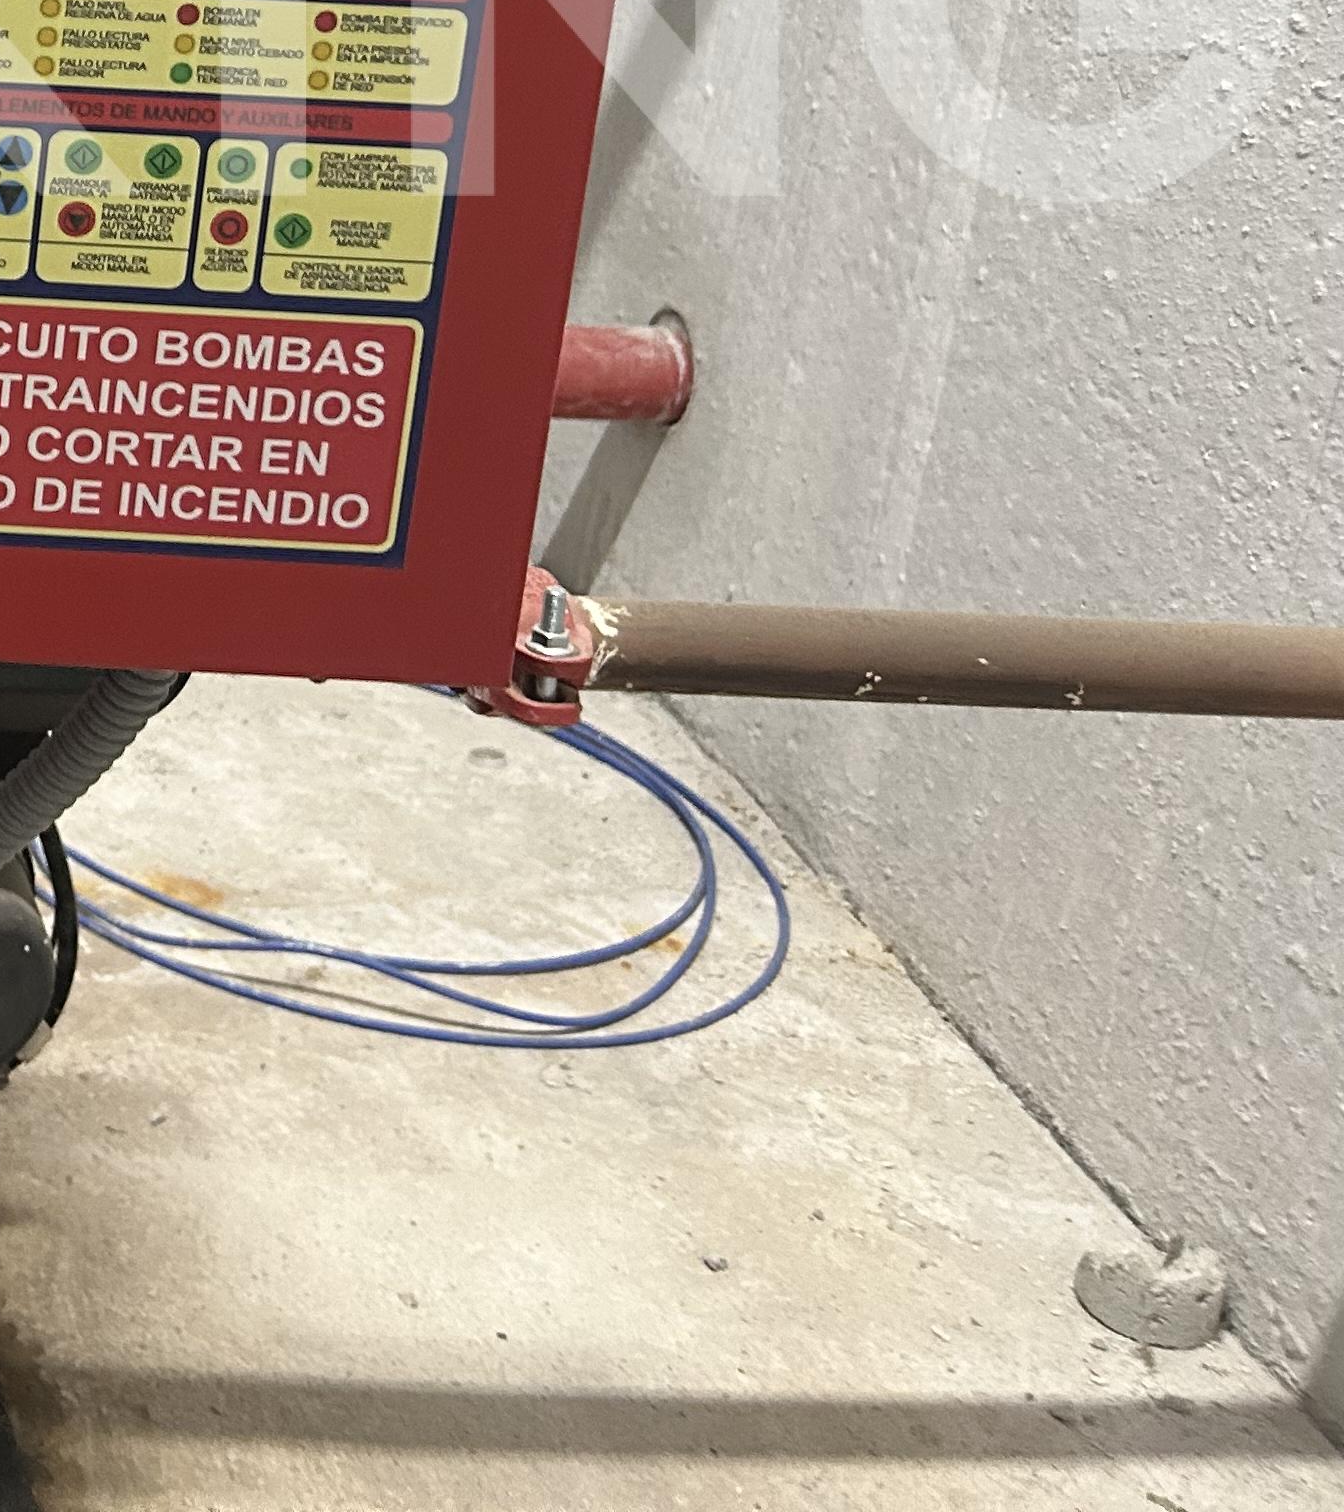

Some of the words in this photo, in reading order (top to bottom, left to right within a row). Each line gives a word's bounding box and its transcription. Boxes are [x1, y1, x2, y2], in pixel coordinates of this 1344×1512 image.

[108, 103, 136, 120] DE
[144, 105, 216, 124] MANDO
[222, 108, 233, 123] Y
[238, 109, 353, 130] AUXILIARES
[154, 329, 387, 378] BOMBAS
[27, 426, 244, 473] CORTAR
[260, 438, 330, 477] EN
[32, 476, 103, 516] DE
[119, 483, 371, 530] INCENDIO
